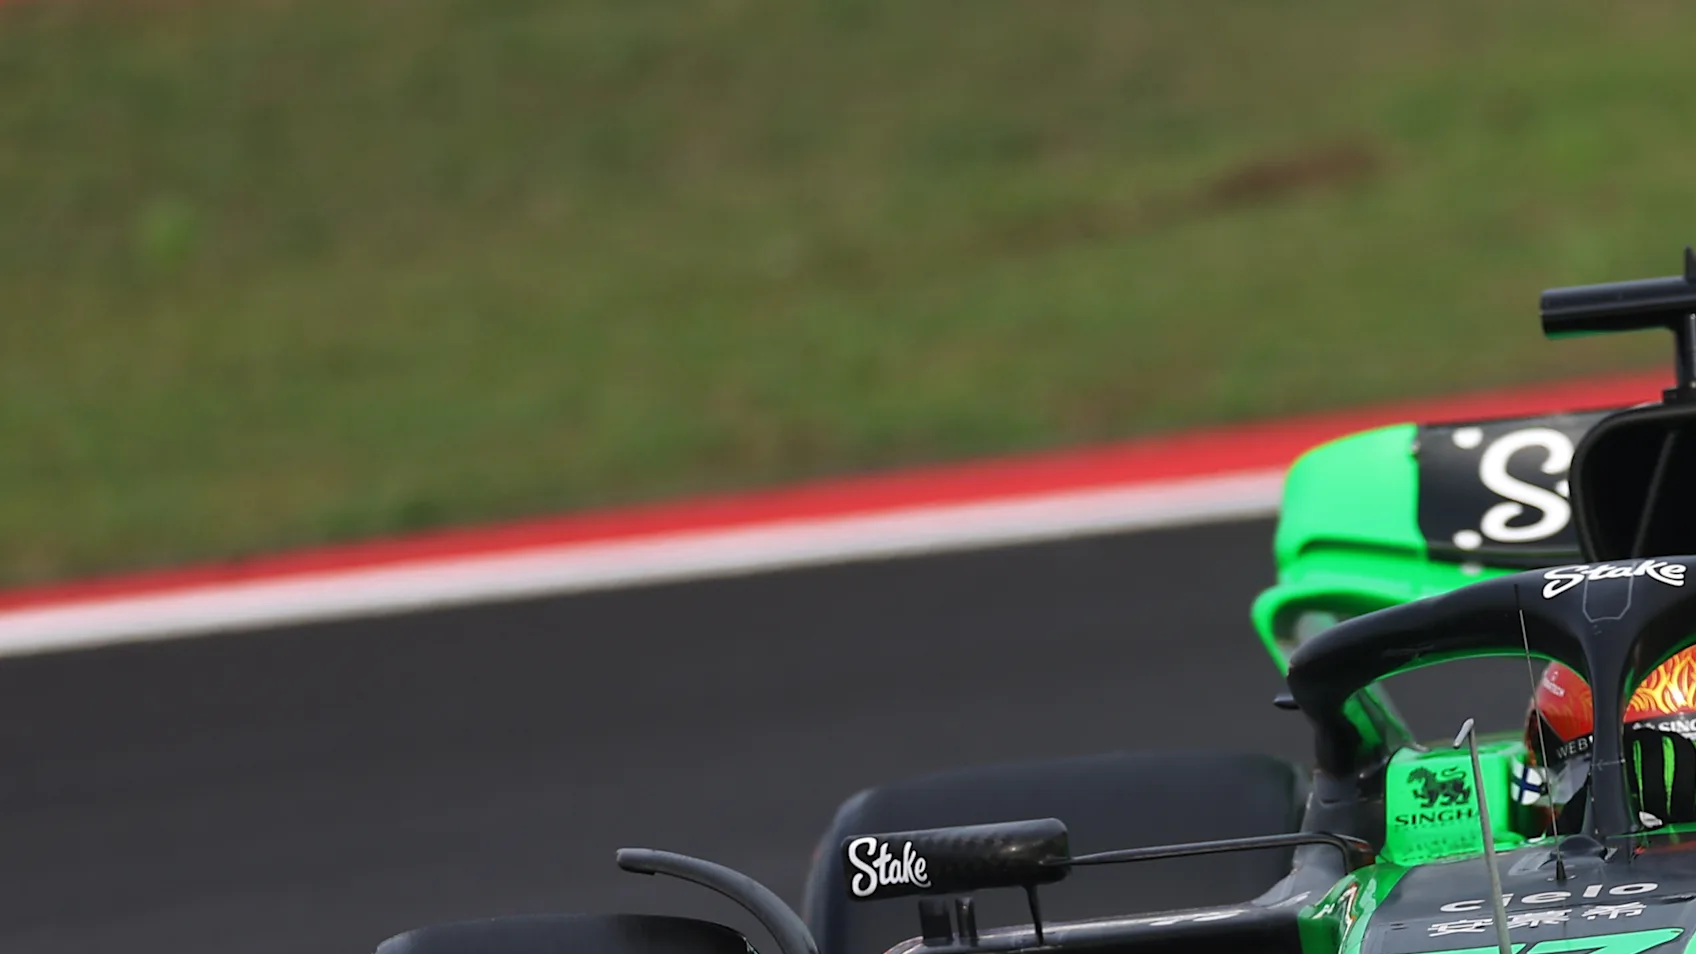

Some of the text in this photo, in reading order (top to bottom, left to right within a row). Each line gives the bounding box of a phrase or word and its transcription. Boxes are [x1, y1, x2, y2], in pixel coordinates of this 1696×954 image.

[1542, 559, 1687, 599] Stake
[1395, 808, 1480, 826] SINGH
[847, 836, 932, 897] Stake
